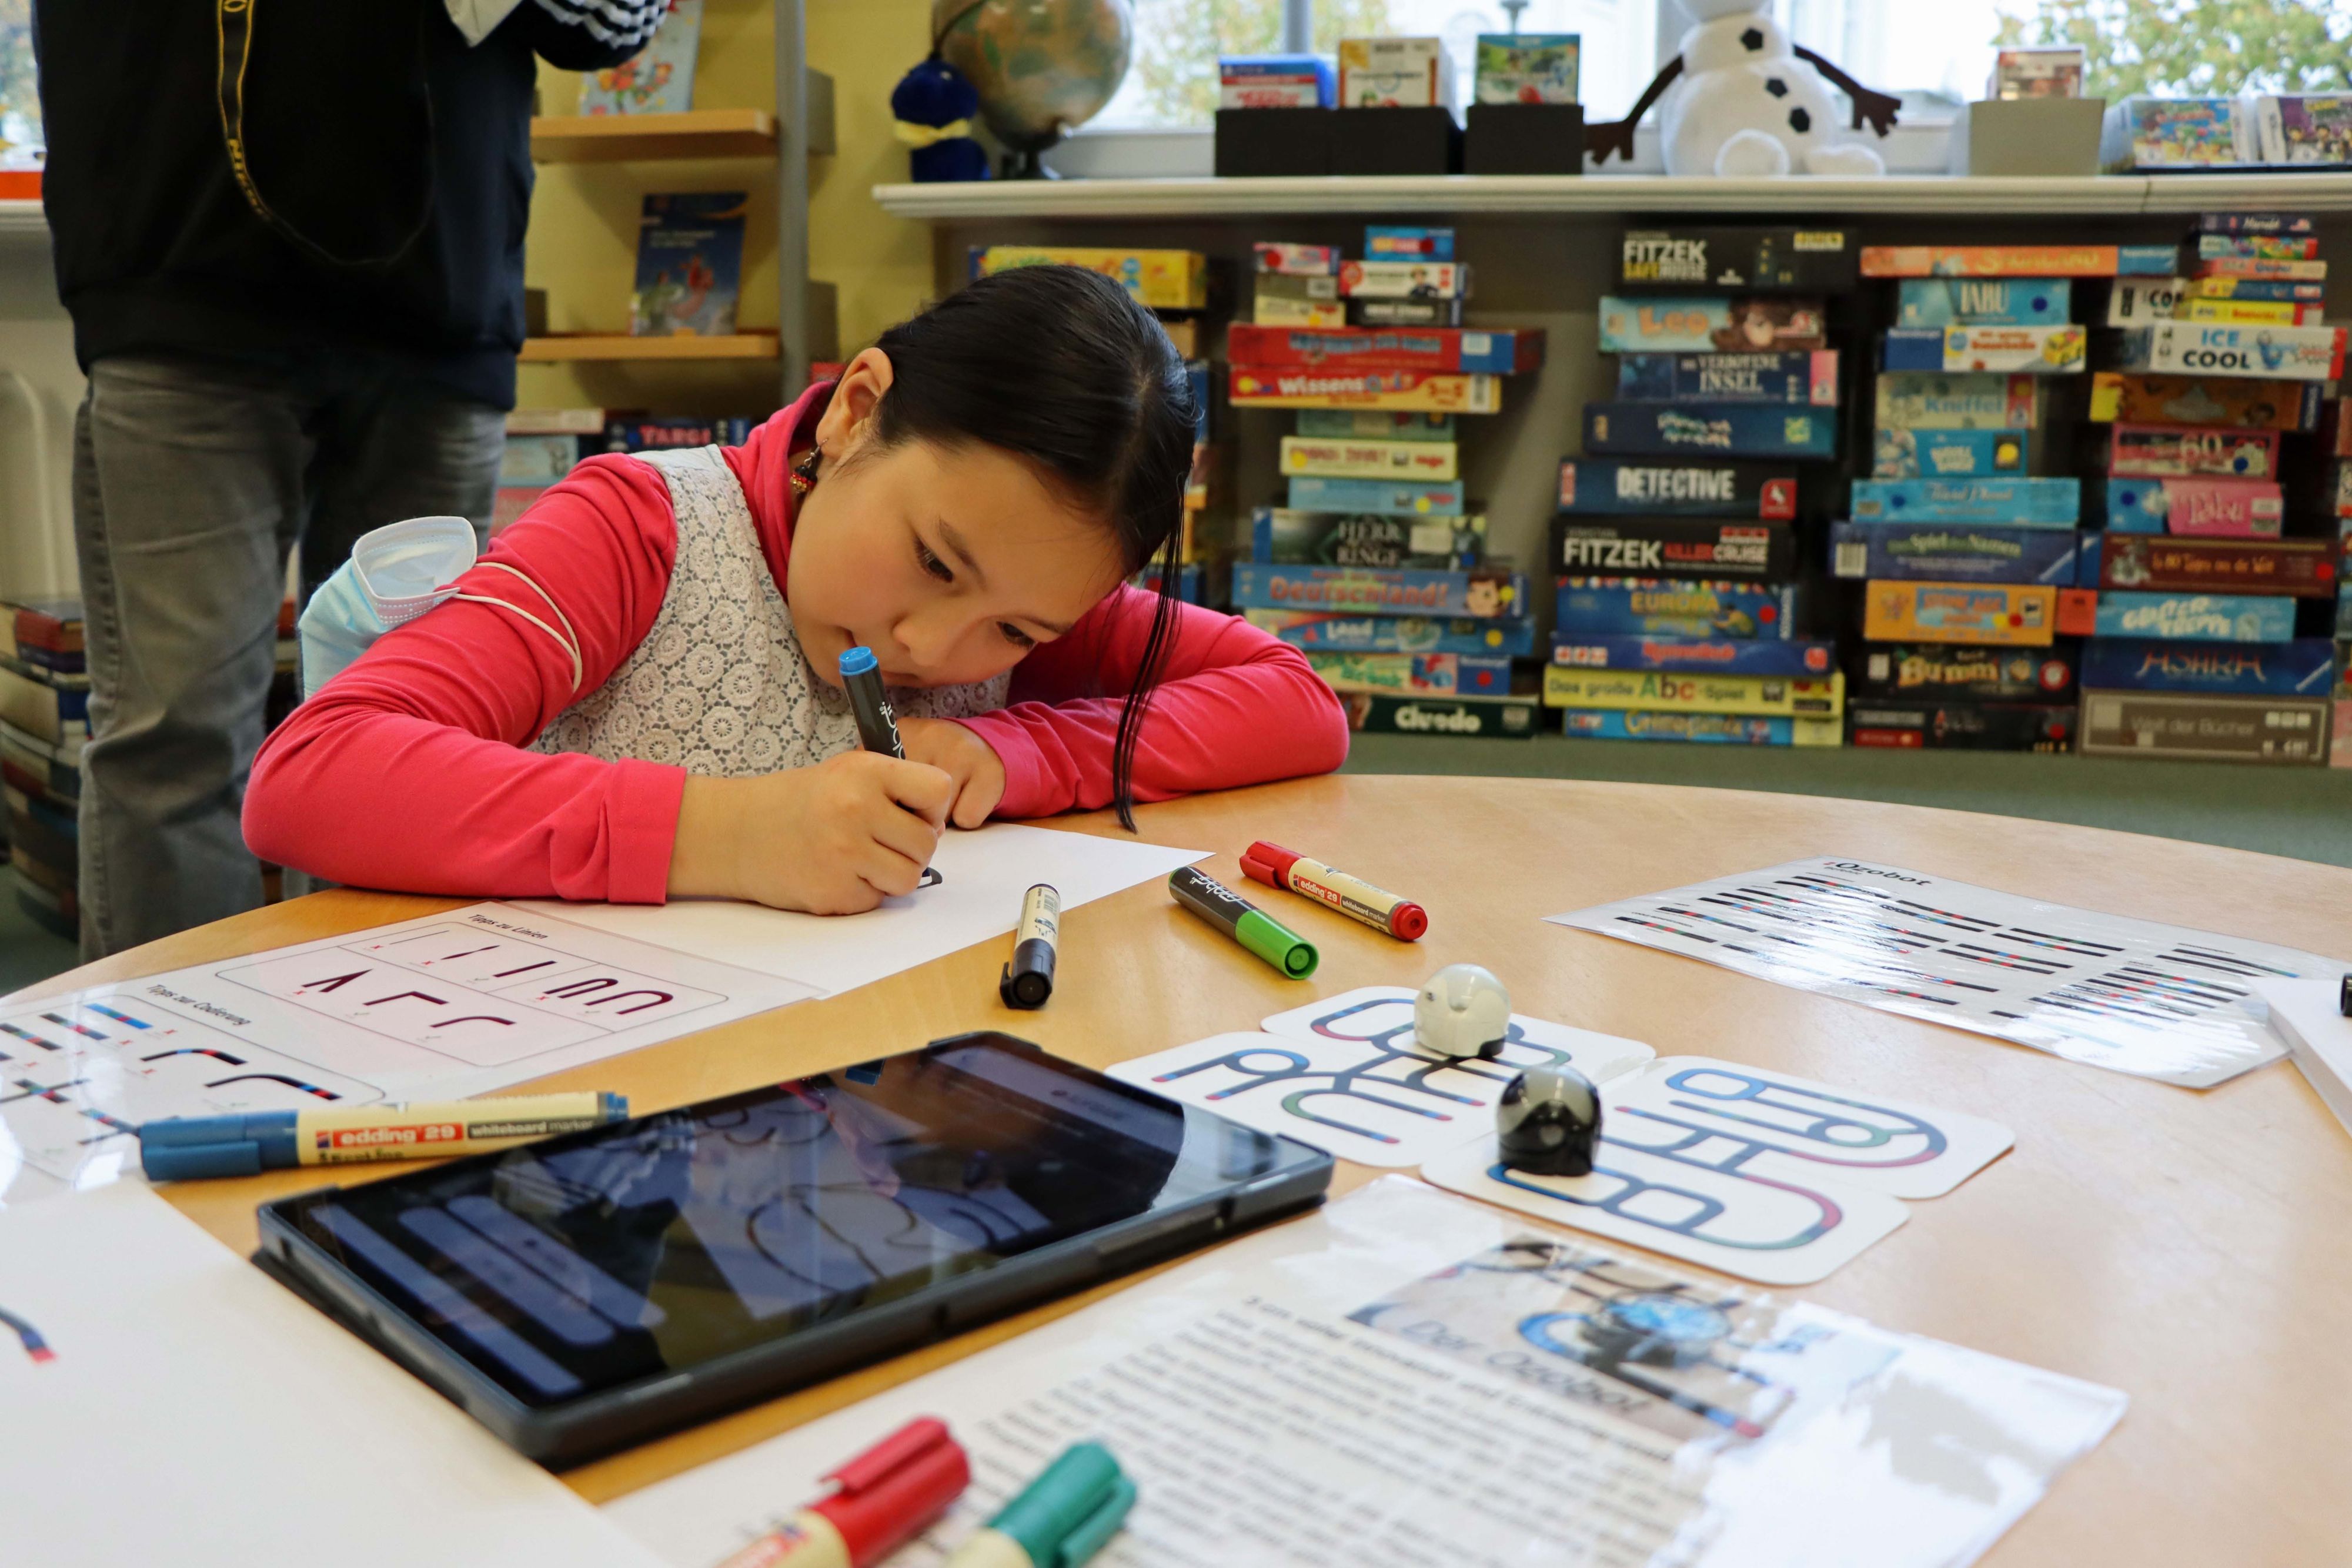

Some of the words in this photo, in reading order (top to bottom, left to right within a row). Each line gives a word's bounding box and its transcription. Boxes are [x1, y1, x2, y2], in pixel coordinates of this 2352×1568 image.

[1624, 239, 1708, 262] FITZEK
[1638, 306, 1709, 337] Leo
[2201, 329, 2240, 347] ICE
[2182, 350, 2251, 370] COOL
[1699, 371, 1763, 392] INSEL
[1616, 466, 1736, 500] DETECTIVE
[1563, 538, 1662, 569] FITZEK
[1269, 576, 1449, 607] Deutschland!
[1835, 862, 1933, 886] Ozobot
[1300, 878, 1326, 897] edding
[1327, 890, 1338, 903] 29
[1342, 899, 1369, 916] whiteboard
[1369, 910, 1387, 923] marker
[468, 914, 499, 925] Tipps
[511, 927, 549, 939] Linien
[146, 984, 178, 997] Tipps
[192, 1002, 252, 1026] Codierung
[340, 1127, 415, 1148] edding
[423, 1124, 456, 1141] 29
[469, 1122, 546, 1136] whiteboard
[549, 1119, 595, 1133] marker
